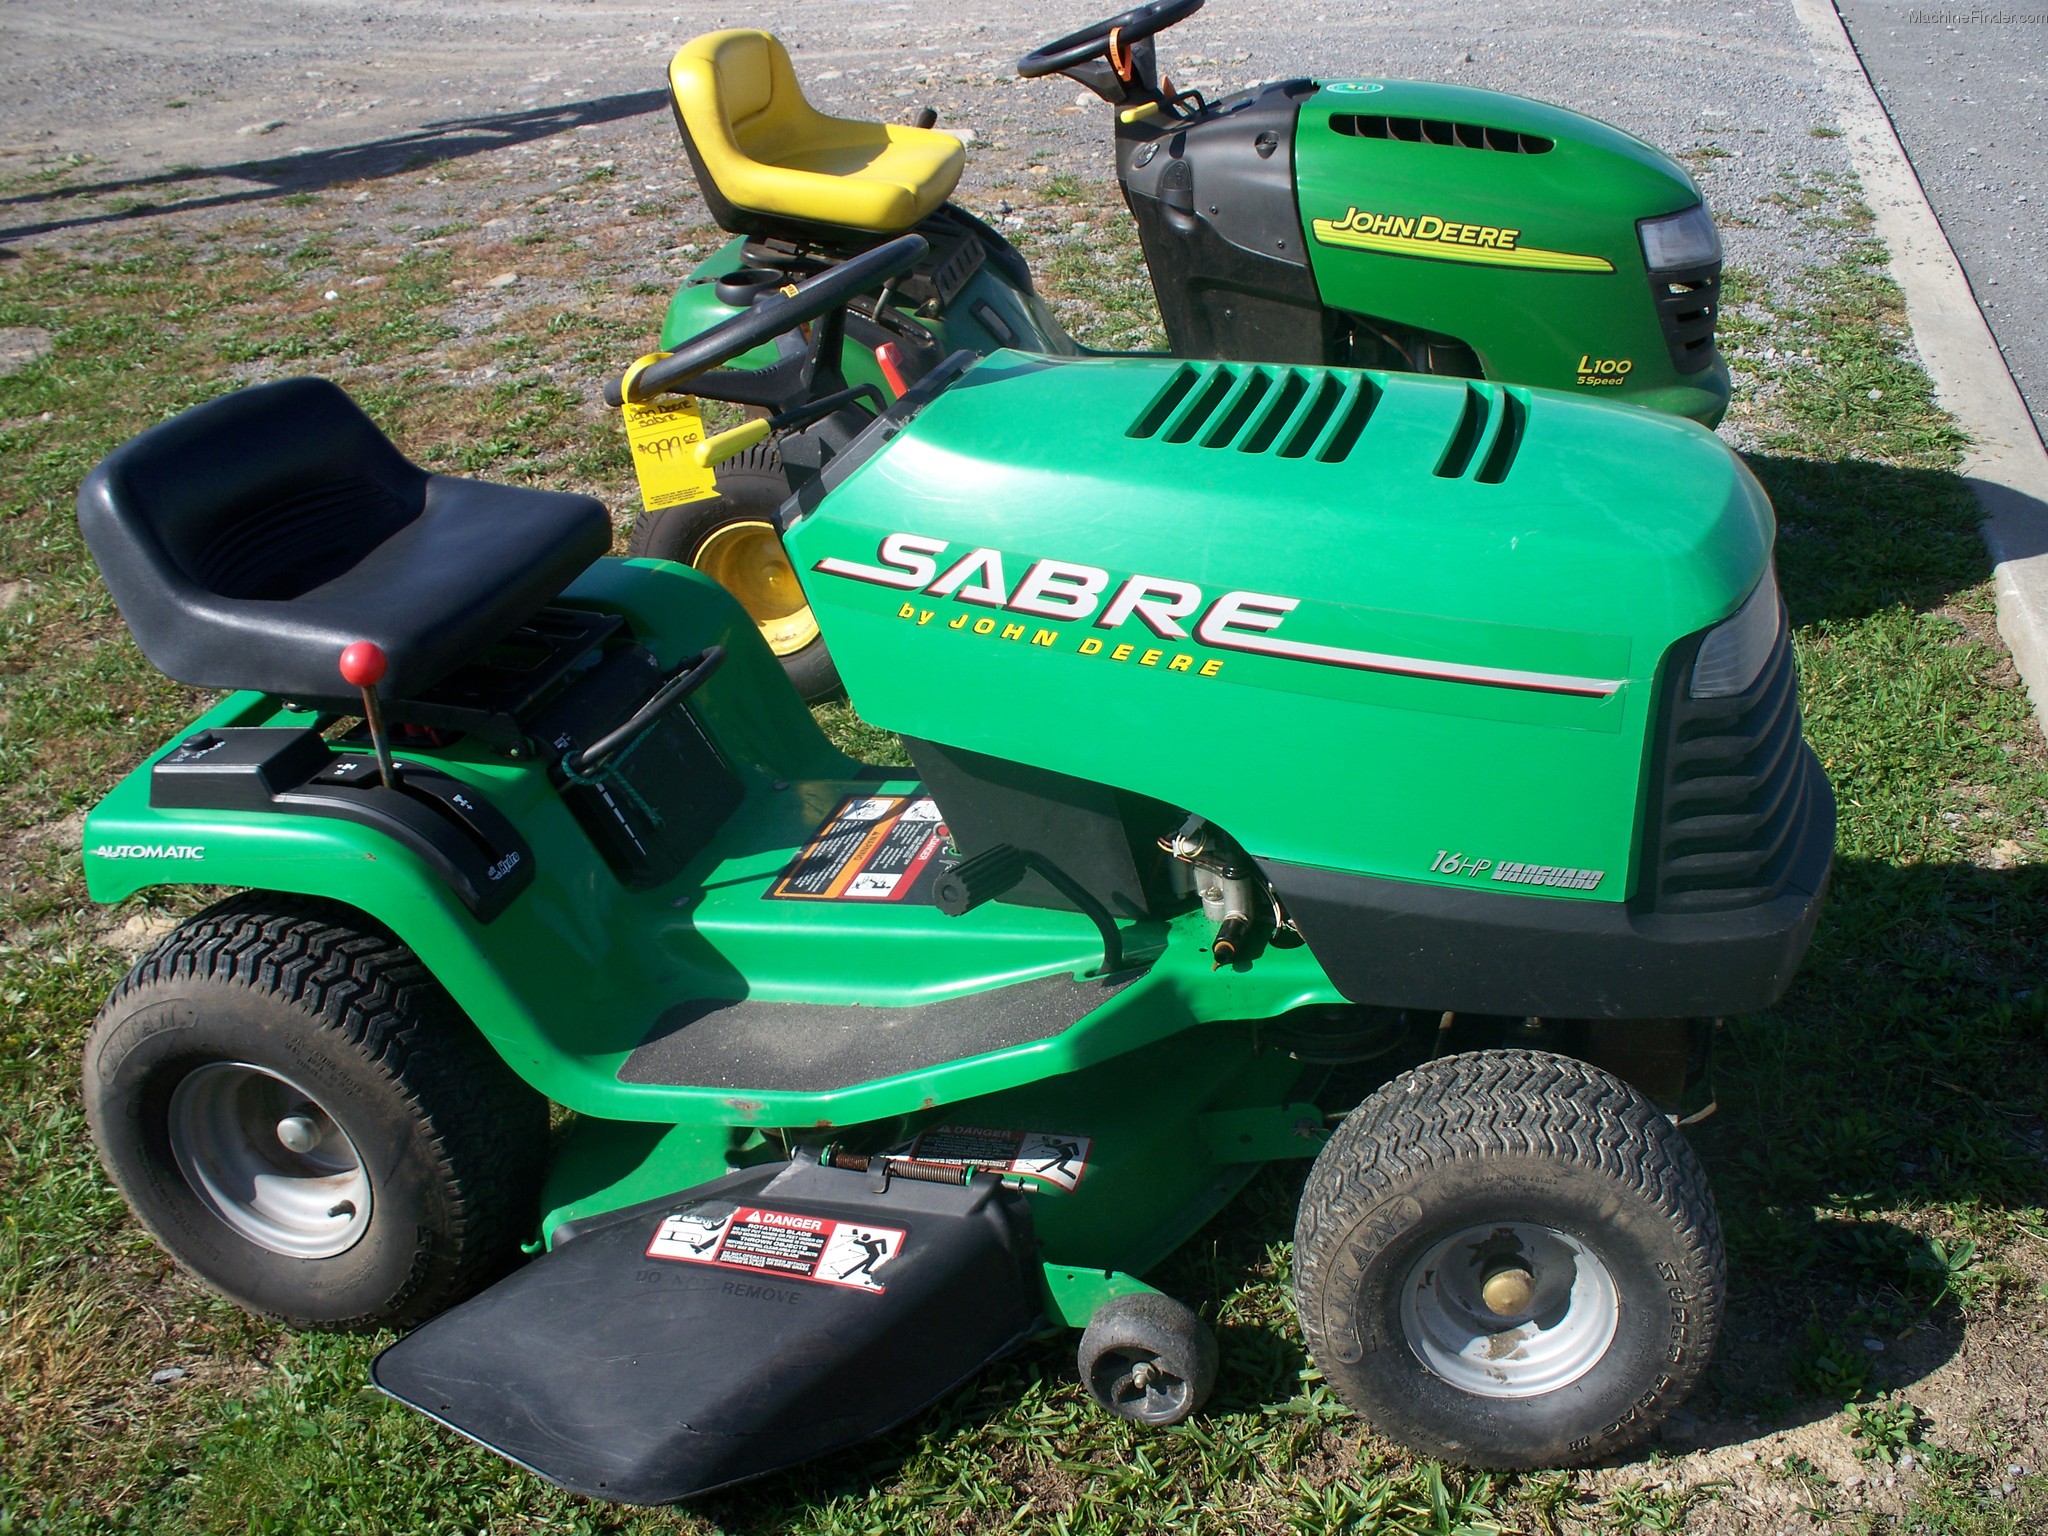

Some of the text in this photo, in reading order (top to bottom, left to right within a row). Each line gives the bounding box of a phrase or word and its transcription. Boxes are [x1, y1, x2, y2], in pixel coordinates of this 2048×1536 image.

[1332, 206, 1521, 250] JOHN DEERE
[1576, 354, 1632, 374] L100
[877, 532, 1301, 648] SABRE
[898, 602, 1225, 677] by JOHN DEERE
[96, 844, 206, 859] AUTOMATIC
[954, 1125, 1012, 1138] DANGER
[747, 1223, 812, 1237] ROTATING BLADE
[762, 1212, 822, 1230] DANGER
[739, 1236, 808, 1251] THROWN OBJECTS
[1326, 1207, 1397, 1340] TITAN
[721, 1281, 803, 1305] REMOVE
[1655, 1261, 1688, 1364] SUPER
[1600, 1373, 1670, 1437] TRAC
